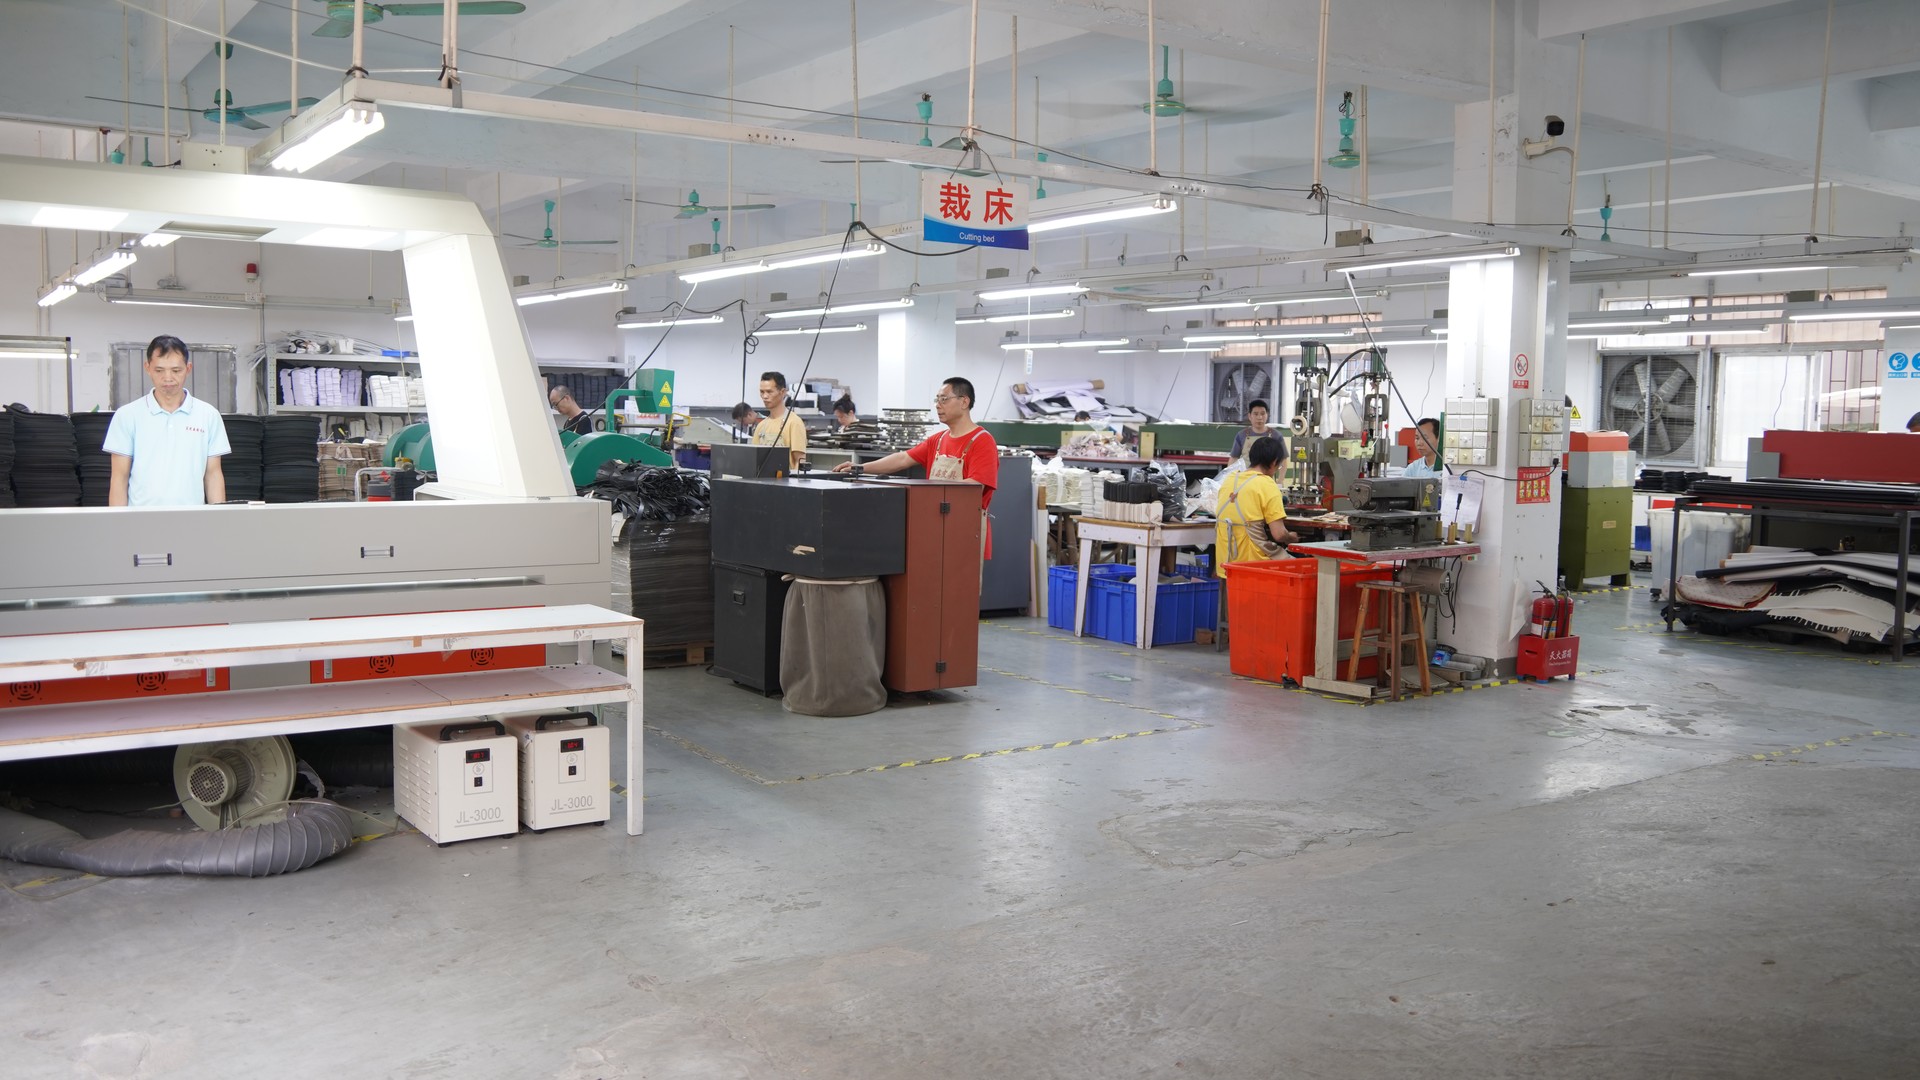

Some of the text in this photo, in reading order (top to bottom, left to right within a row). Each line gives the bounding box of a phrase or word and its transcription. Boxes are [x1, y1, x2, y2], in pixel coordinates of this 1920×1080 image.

[939, 181, 1014, 225] 裁床
[959, 231, 995, 243] Cutting bed
[551, 794, 593, 811] JL-3000
[456, 806, 501, 824] JL-3000
